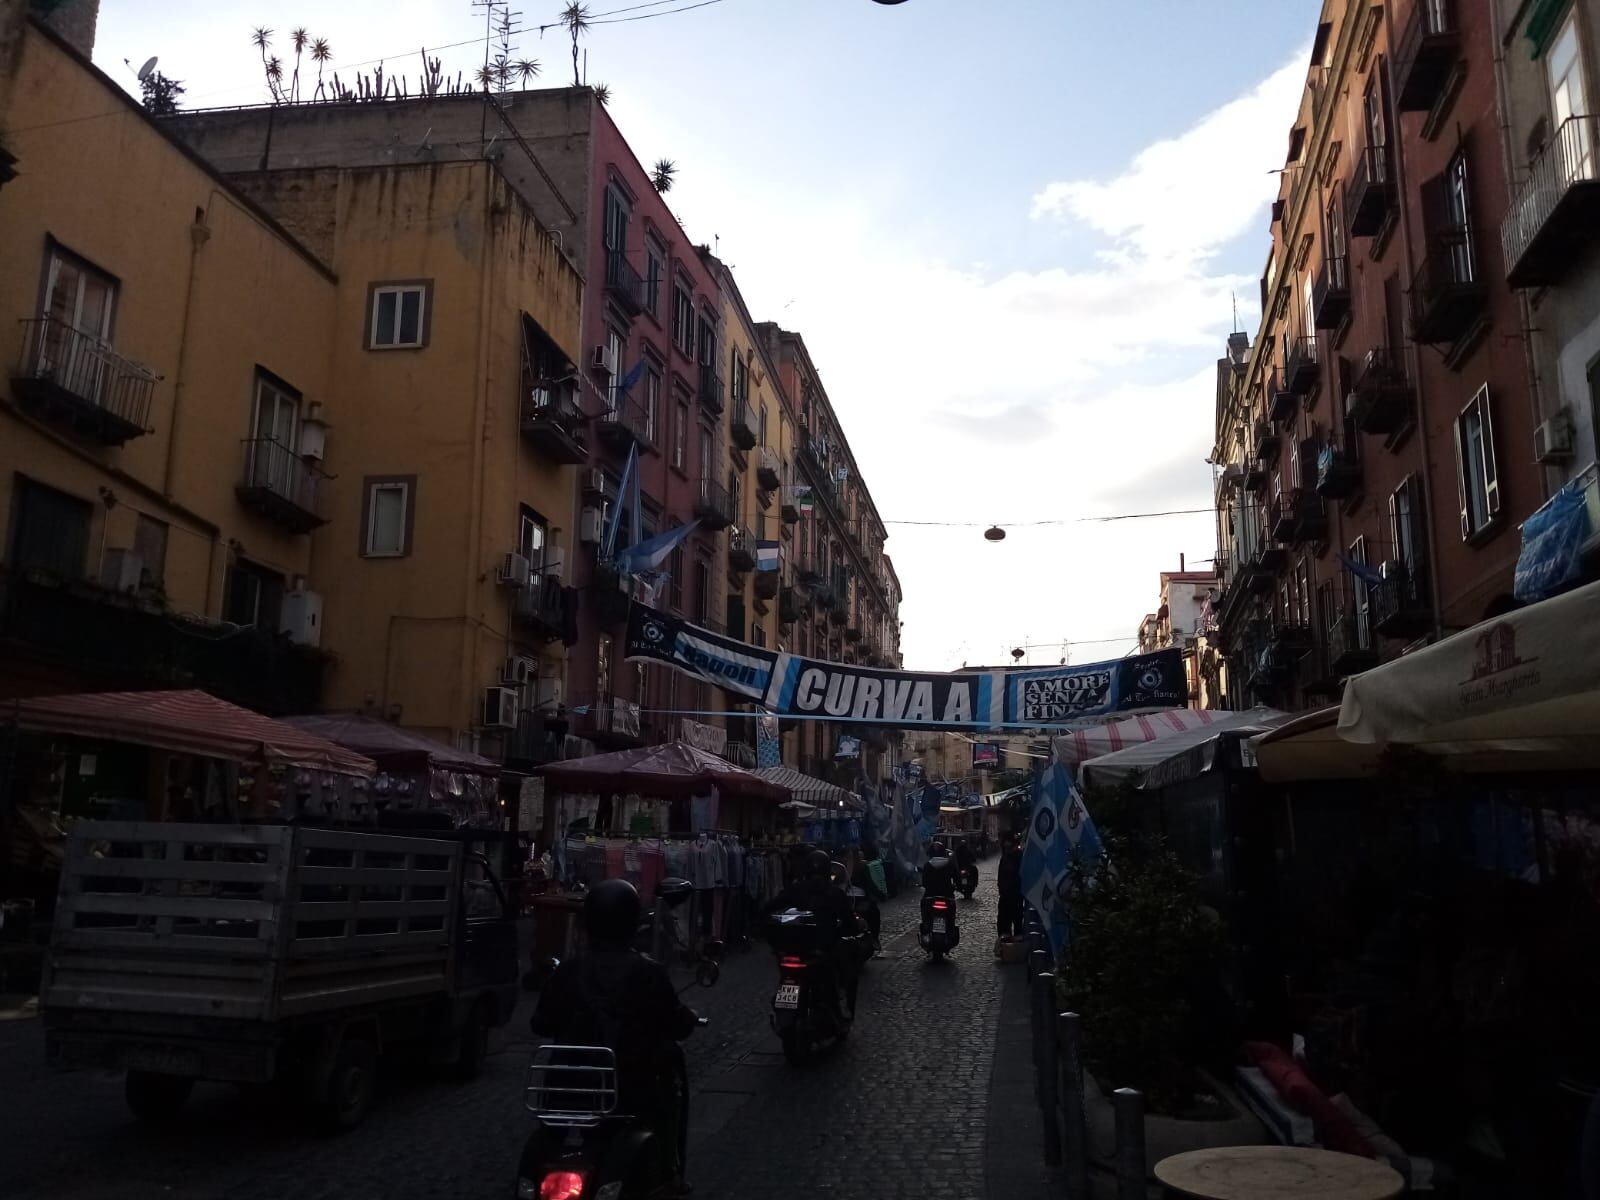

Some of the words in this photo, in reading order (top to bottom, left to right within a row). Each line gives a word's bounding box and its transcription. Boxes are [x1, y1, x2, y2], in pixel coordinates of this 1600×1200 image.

[1026, 671, 1110, 694] AMORE
[796, 667, 934, 721] CURVA
[943, 681, 972, 722] A
[1025, 688, 1098, 705] SENZA
